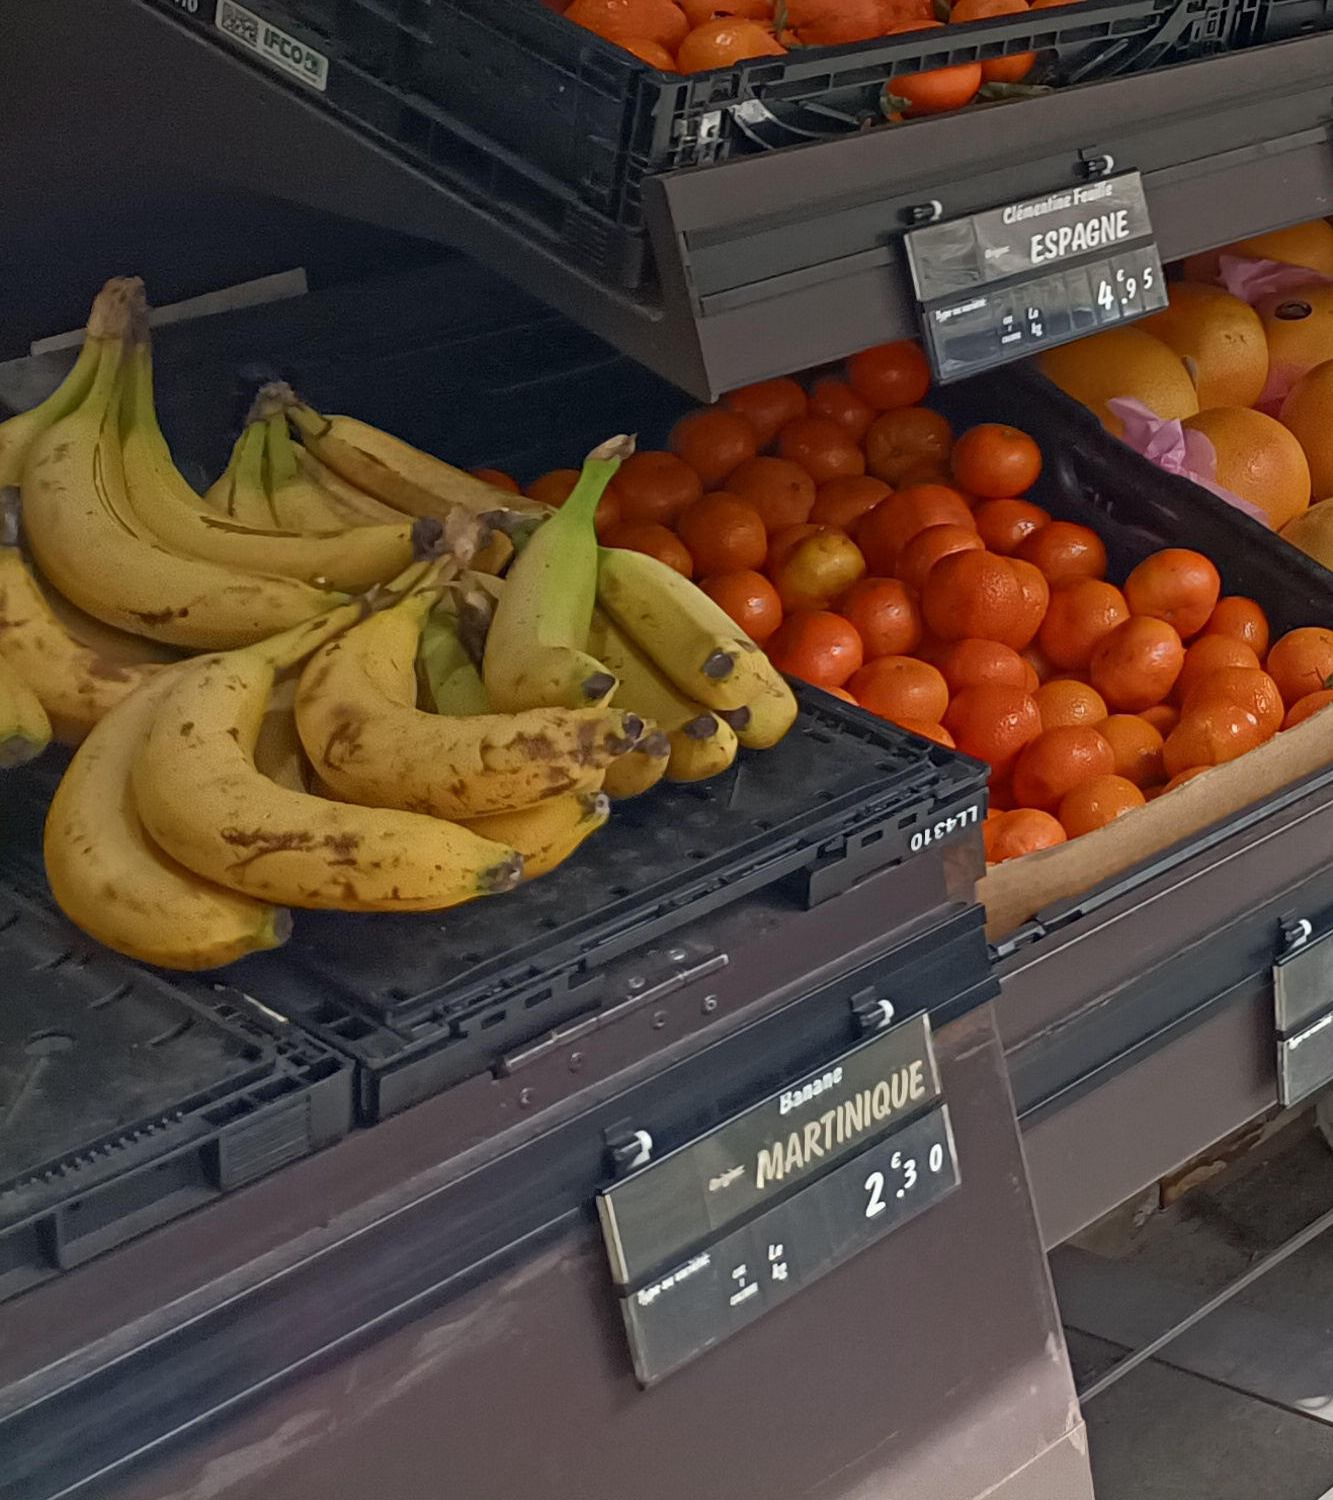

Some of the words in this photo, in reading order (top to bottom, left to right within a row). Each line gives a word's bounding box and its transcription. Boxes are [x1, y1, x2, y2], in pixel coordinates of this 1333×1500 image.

[263, 27, 303, 65] IFCO
[1002, 192, 1073, 225] Clémentine
[1030, 209, 1131, 264] ESPAGNE
[911, 805, 979, 852] LL4310
[779, 1066, 843, 1116] Banane
[756, 1060, 925, 1190] MARTINIQUE
